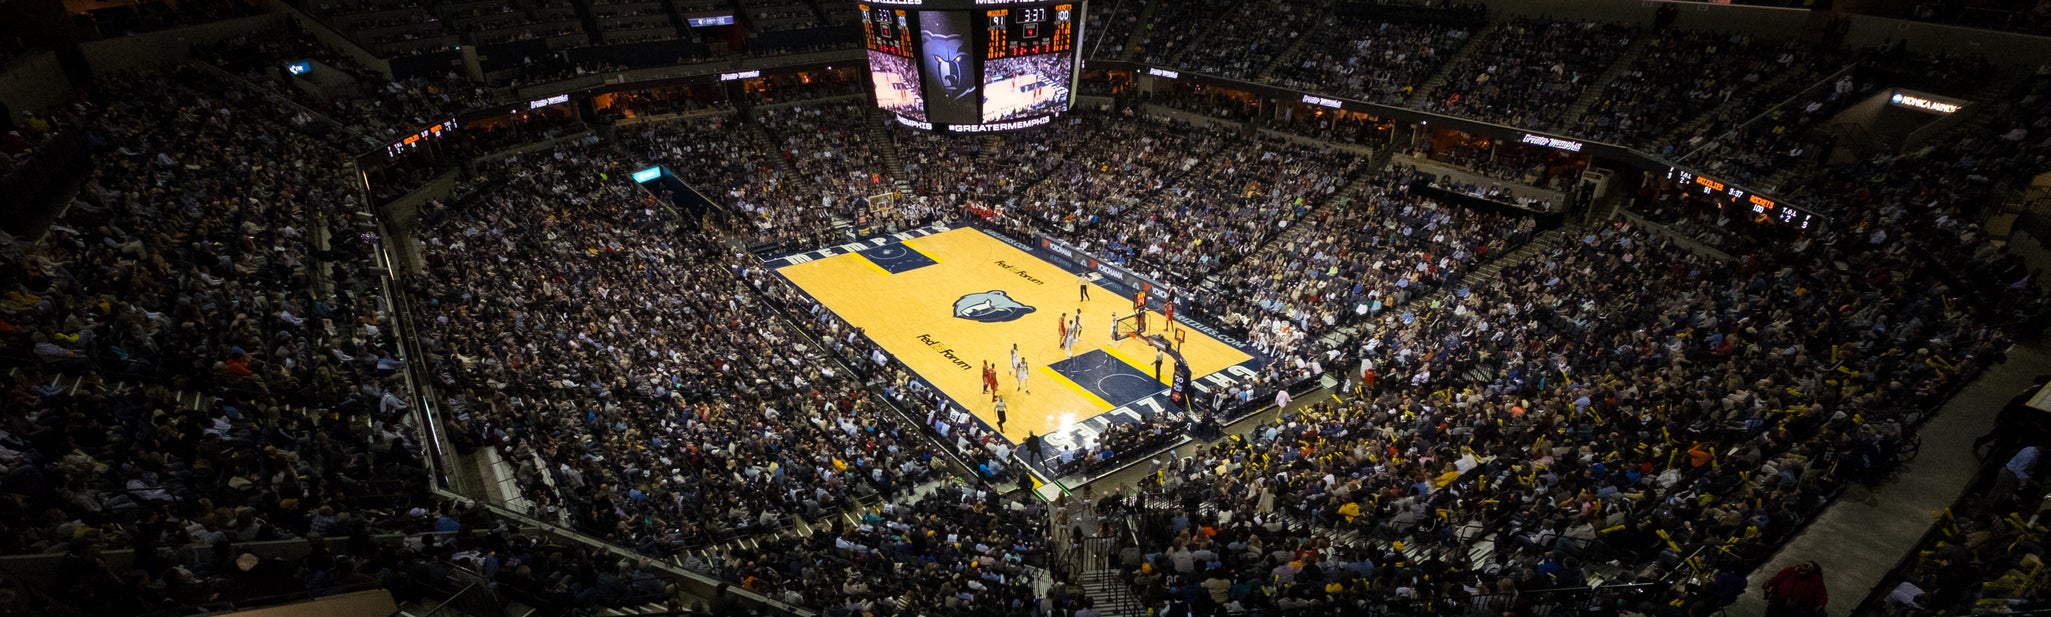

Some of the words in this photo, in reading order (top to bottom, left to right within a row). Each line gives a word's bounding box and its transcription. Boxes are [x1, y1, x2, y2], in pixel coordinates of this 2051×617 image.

[993, 16, 1004, 26] 91
[1024, 8, 1045, 22] 3:37
[1049, 242, 1073, 258] YOKOHAMA
[995, 260, 1044, 286] FedForum
[1097, 262, 1123, 281] YOKOHAMA
[1152, 287, 1182, 305] YOKOMA
[917, 334, 972, 371] FedForum
